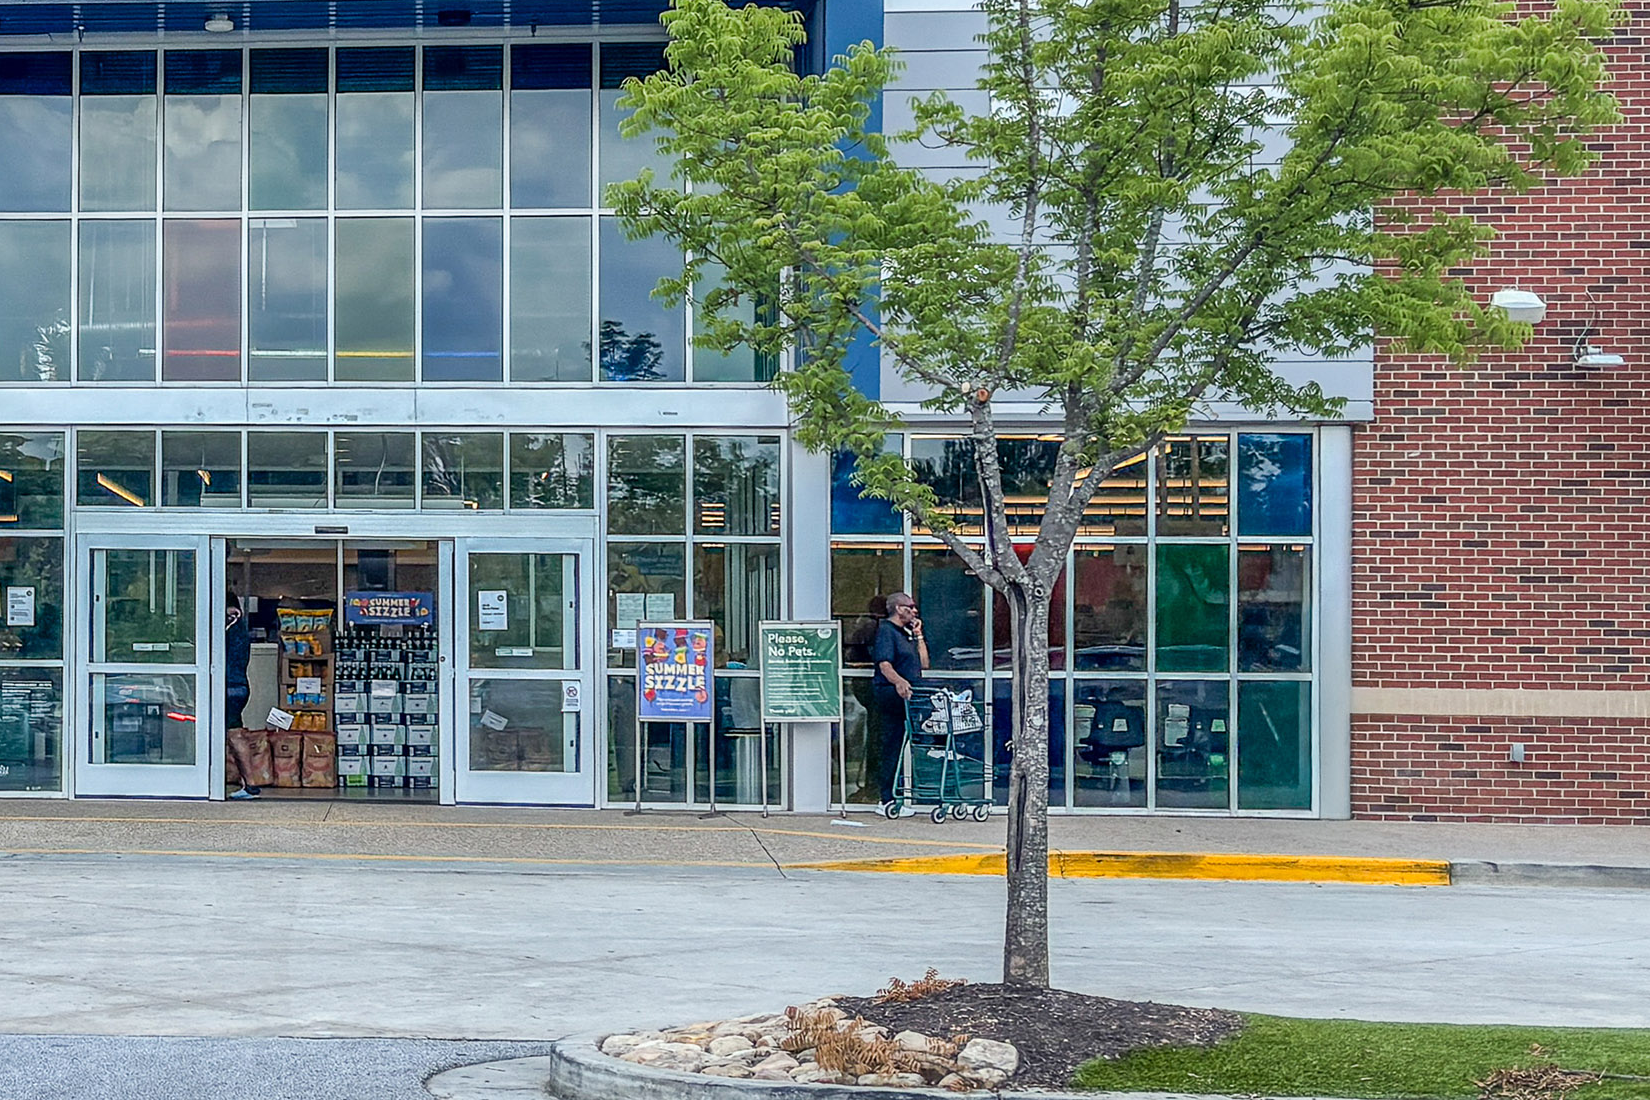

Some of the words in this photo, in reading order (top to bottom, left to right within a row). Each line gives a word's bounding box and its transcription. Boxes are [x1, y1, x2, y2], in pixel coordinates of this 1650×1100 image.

[369, 598, 410, 607] SUMMER
[368, 607, 410, 617] SIZZLE
[768, 633, 808, 644] Please,
[768, 646, 785, 656] No
[788, 646, 816, 656] Pets.
[645, 663, 705, 675] SUMMER
[644, 675, 706, 692] SIZZLE
